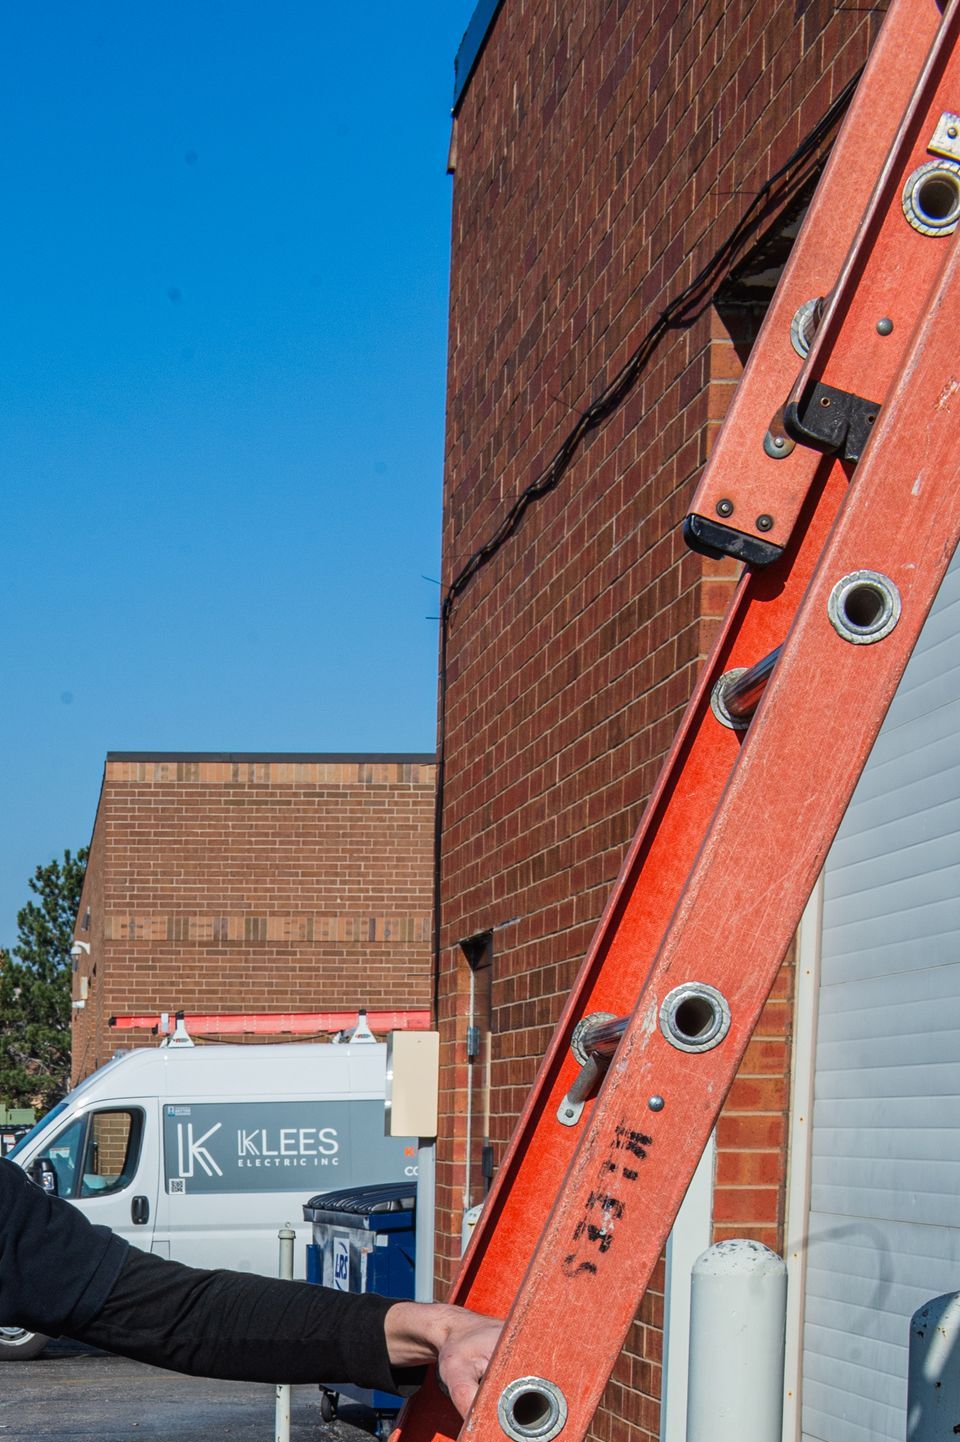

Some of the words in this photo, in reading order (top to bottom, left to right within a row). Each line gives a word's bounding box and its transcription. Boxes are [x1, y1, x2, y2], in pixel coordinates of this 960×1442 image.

[237, 1128, 339, 1156] KLEES
[238, 1158, 307, 1167] ELECTRIC
[314, 1157, 339, 1166] INC
[335, 1254, 348, 1279] LRS
